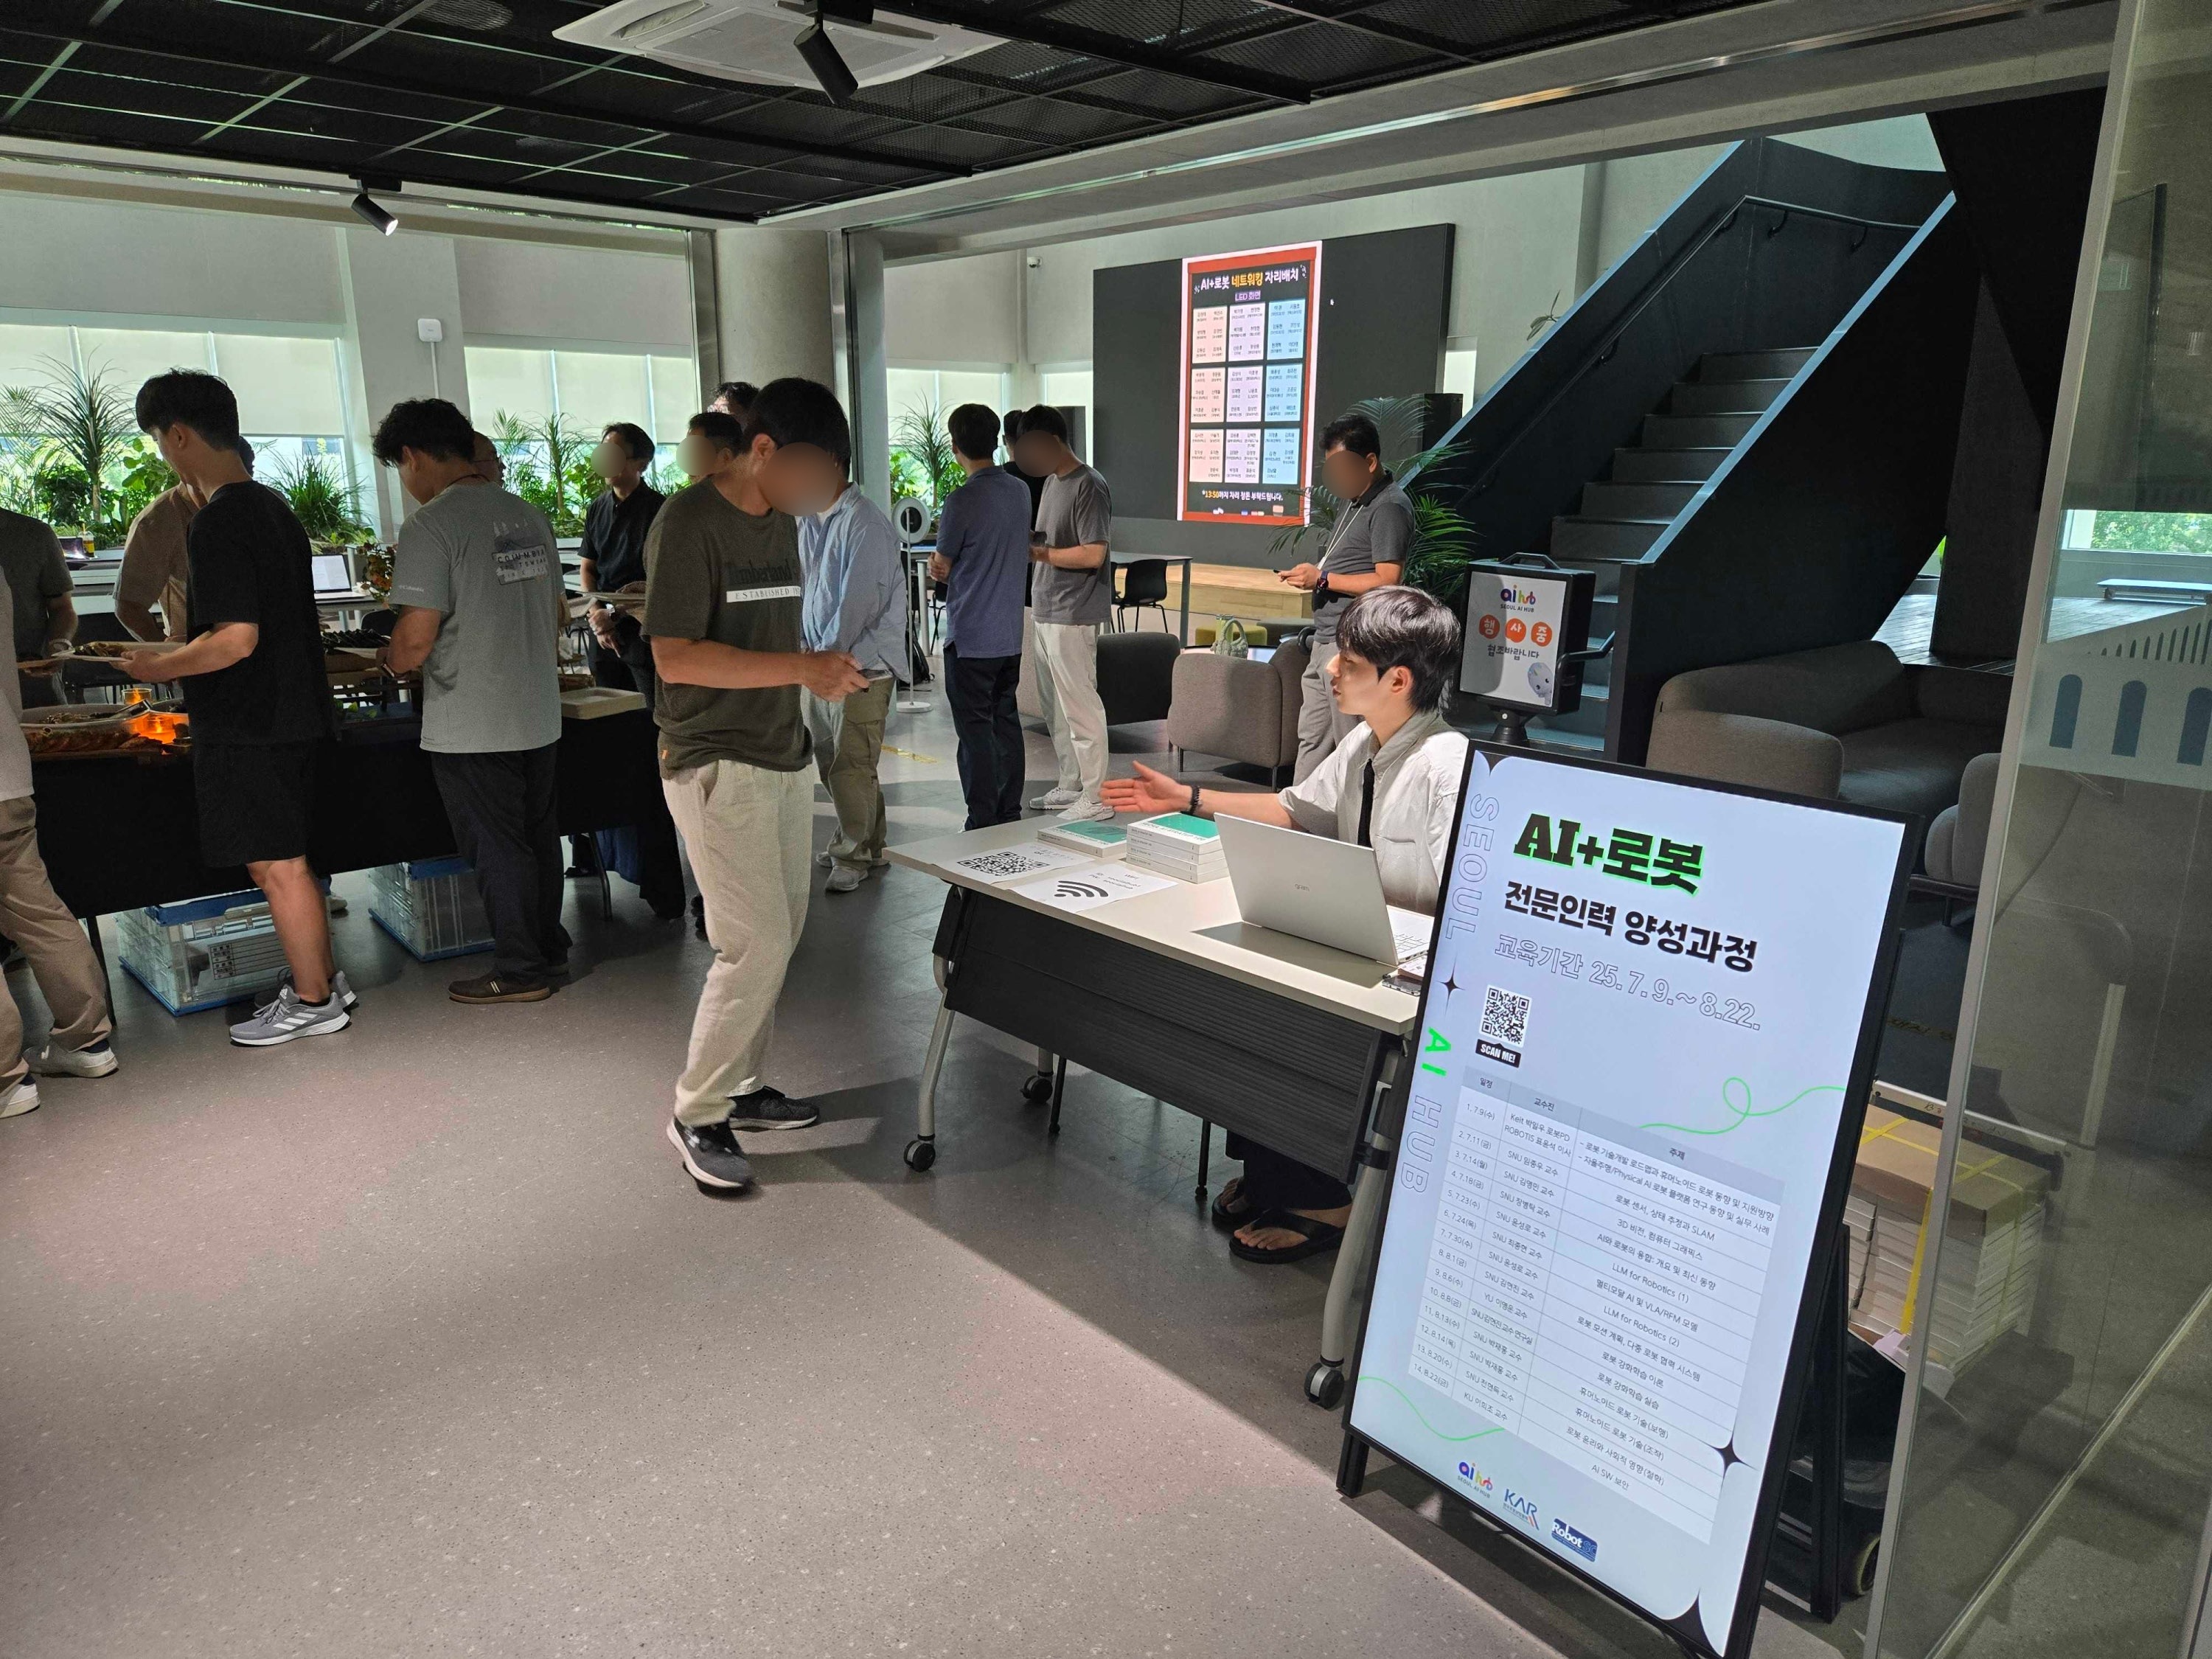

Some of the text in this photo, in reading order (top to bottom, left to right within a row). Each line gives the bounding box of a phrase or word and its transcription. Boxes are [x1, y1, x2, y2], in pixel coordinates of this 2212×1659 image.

[1200, 268, 1299, 291] AI+로봇 네트워킹 자리배치
[1235, 290, 1261, 301] LED 화면
[1229, 490, 1239, 500] 자리
[735, 588, 790, 600] ESTABLISHED
[1500, 603, 1517, 611] SEOUL
[1486, 644, 1540, 661] 협조바랍니다
[1512, 812, 1704, 896] AI+로봇
[1295, 883, 1310, 892] gram
[1503, 880, 1759, 973] 전문인력 양성과정
[1493, 933, 1585, 981] 교육기간
[1400, 793, 1500, 1193] SEOUL AI HUB
[1480, 1043, 1516, 1063] SCAN ME!
[1479, 1077, 1494, 1090] 일정
[1533, 1096, 1556, 1113] 교수진
[1503, 1124, 1536, 1143] ROBOTIS
[1557, 1144, 1572, 1158] 이사
[1509, 1113, 1571, 1143] Keit 로봇PD
[1506, 1150, 1559, 1178] SNU 교수
[1668, 1147, 1686, 1162] 주제
[1503, 1169, 1520, 1183] SNU
[1585, 1141, 1601, 1155] 로봇
[1599, 1147, 1630, 1166] 기술개발
[1659, 1170, 1697, 1192] 휴머노이드
[1697, 1184, 1714, 1200] 로봇
[1714, 1191, 1732, 1206] 동향
[1731, 1197, 1742, 1209] 및
[1741, 1201, 1775, 1222] 지원방향
[1614, 1193, 1632, 1208] 로봇
[1649, 1208, 1667, 1222] 상태
[1666, 1214, 1691, 1232] 추정과
[1691, 1225, 1716, 1242] SLAM
[1642, 1179, 1653, 1189] AI
[1651, 1182, 1669, 1197] 로봇
[1691, 1197, 1708, 1211] 연구
[1708, 1204, 1726, 1219] 동향
[1725, 1211, 1735, 1222] 및
[1735, 1215, 1753, 1229] 실무
[1752, 1222, 1770, 1237] 사례
[1615, 1217, 1630, 1230] 3D
[1648, 1231, 1672, 1249] 컴퓨터
[1671, 1241, 1703, 1262] 그래픽스
[1596, 1233, 1613, 1247] AI와
[1611, 1239, 1636, 1257] 로봇의
[1655, 1257, 1672, 1272] 개요
[1672, 1265, 1682, 1276] 및
[1681, 1269, 1699, 1284] 최신
[1699, 1276, 1717, 1292] 동향
[1484, 1292, 1495, 1304] YU
[1611, 1262, 1630, 1277] LLM
[1628, 1269, 1642, 1282] for
[1677, 1291, 1690, 1304] (1)
[1596, 1278, 1627, 1300] 멀티모달
[1624, 1293, 1635, 1304] AI
[1635, 1296, 1644, 1308] 및
[1680, 1318, 1699, 1333] 모델
[1602, 1304, 1621, 1320] LLM
[1620, 1312, 1633, 1325] for
[1668, 1335, 1680, 1349] (2)
[1508, 1349, 1523, 1363] 교수
[1576, 1315, 1593, 1329] 로봇
[1591, 1323, 1609, 1338] 모션
[1626, 1339, 1643, 1354] 다중
[1642, 1347, 1659, 1363] 로봇
[1660, 1355, 1676, 1371] 협력
[1675, 1364, 1701, 1383] 시스템
[1468, 1350, 1519, 1382] SNU 교수
[1601, 1350, 1665, 1389] 로봇 강화학습 이론
[1464, 1370, 1514, 1403] SNU 교수
[1579, 1385, 1616, 1412] 휴머노이드
[1615, 1405, 1632, 1421] 로봇
[1596, 1371, 1660, 1411] 로봇 강화학습 실습
[1463, 1391, 1509, 1422] KU 교수
[1574, 1407, 1612, 1433] 휴머노이드
[1610, 1426, 1628, 1442] 로봇
[1565, 1425, 1582, 1441] 로봇
[1582, 1434, 1605, 1453] 윤리와
[1604, 1447, 1628, 1467] 사회적
[1457, 1475, 1473, 1489] SEOUL
[1479, 1489, 1491, 1499] HUB
[1590, 1464, 1630, 1492] AI SW 보안
[1504, 1488, 1540, 1531] KAR
